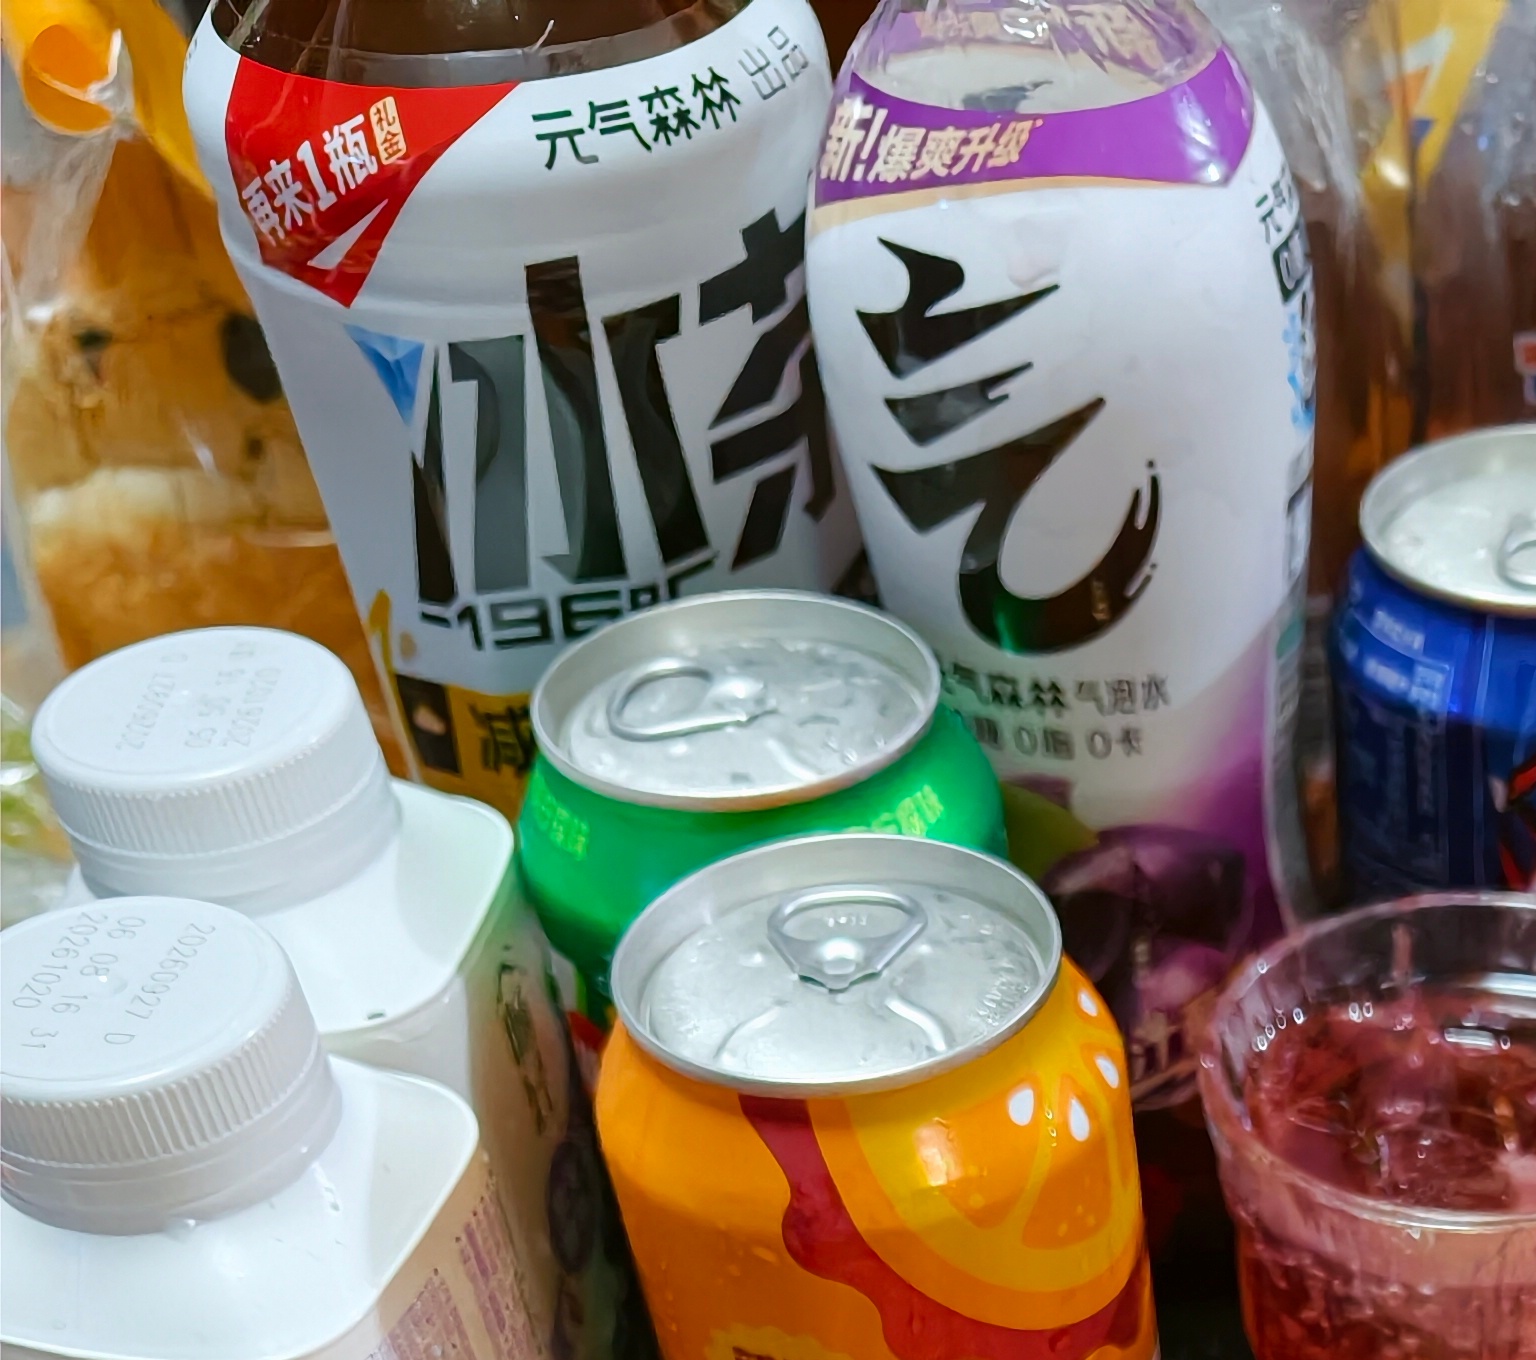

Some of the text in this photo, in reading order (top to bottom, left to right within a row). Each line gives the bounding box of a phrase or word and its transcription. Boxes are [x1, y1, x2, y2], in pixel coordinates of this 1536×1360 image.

[372, 100, 404, 161] 礼金
[531, 66, 741, 170] 元气森林
[738, 25, 809, 100] 出品
[242, 113, 379, 247] 再来1瓶
[855, 236, 1164, 657] 气
[12, 911, 108, 1009] 20261020
[20, 916, 146, 1049] 06 08 16 31
[125, 923, 216, 1020] 20260927
